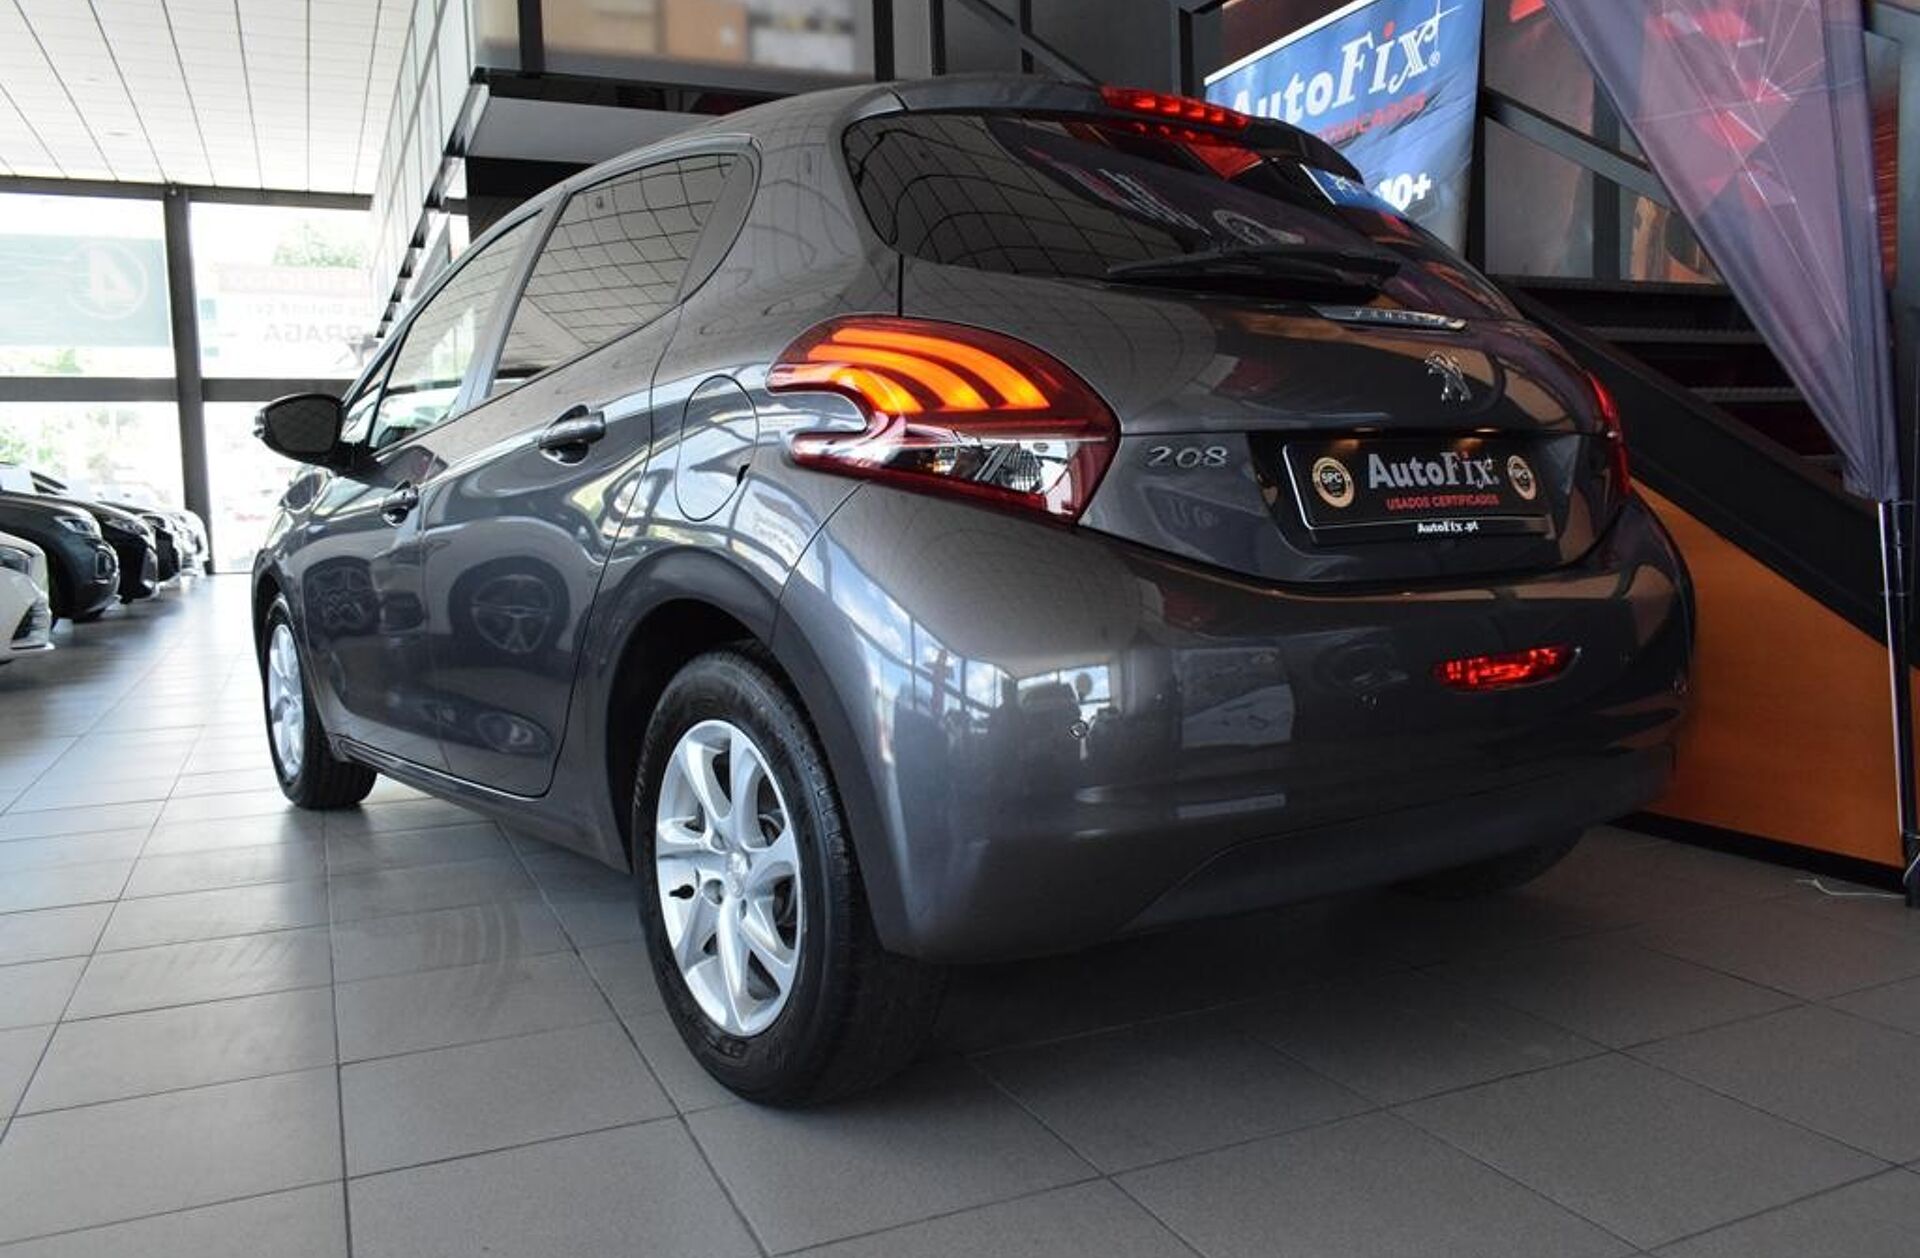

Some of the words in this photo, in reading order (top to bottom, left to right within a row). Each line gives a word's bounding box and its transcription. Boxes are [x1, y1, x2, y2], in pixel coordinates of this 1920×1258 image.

[1148, 445, 1228, 468] 208
[1368, 452, 1496, 489] AutoFix
[1386, 496, 1429, 510] USADOS
